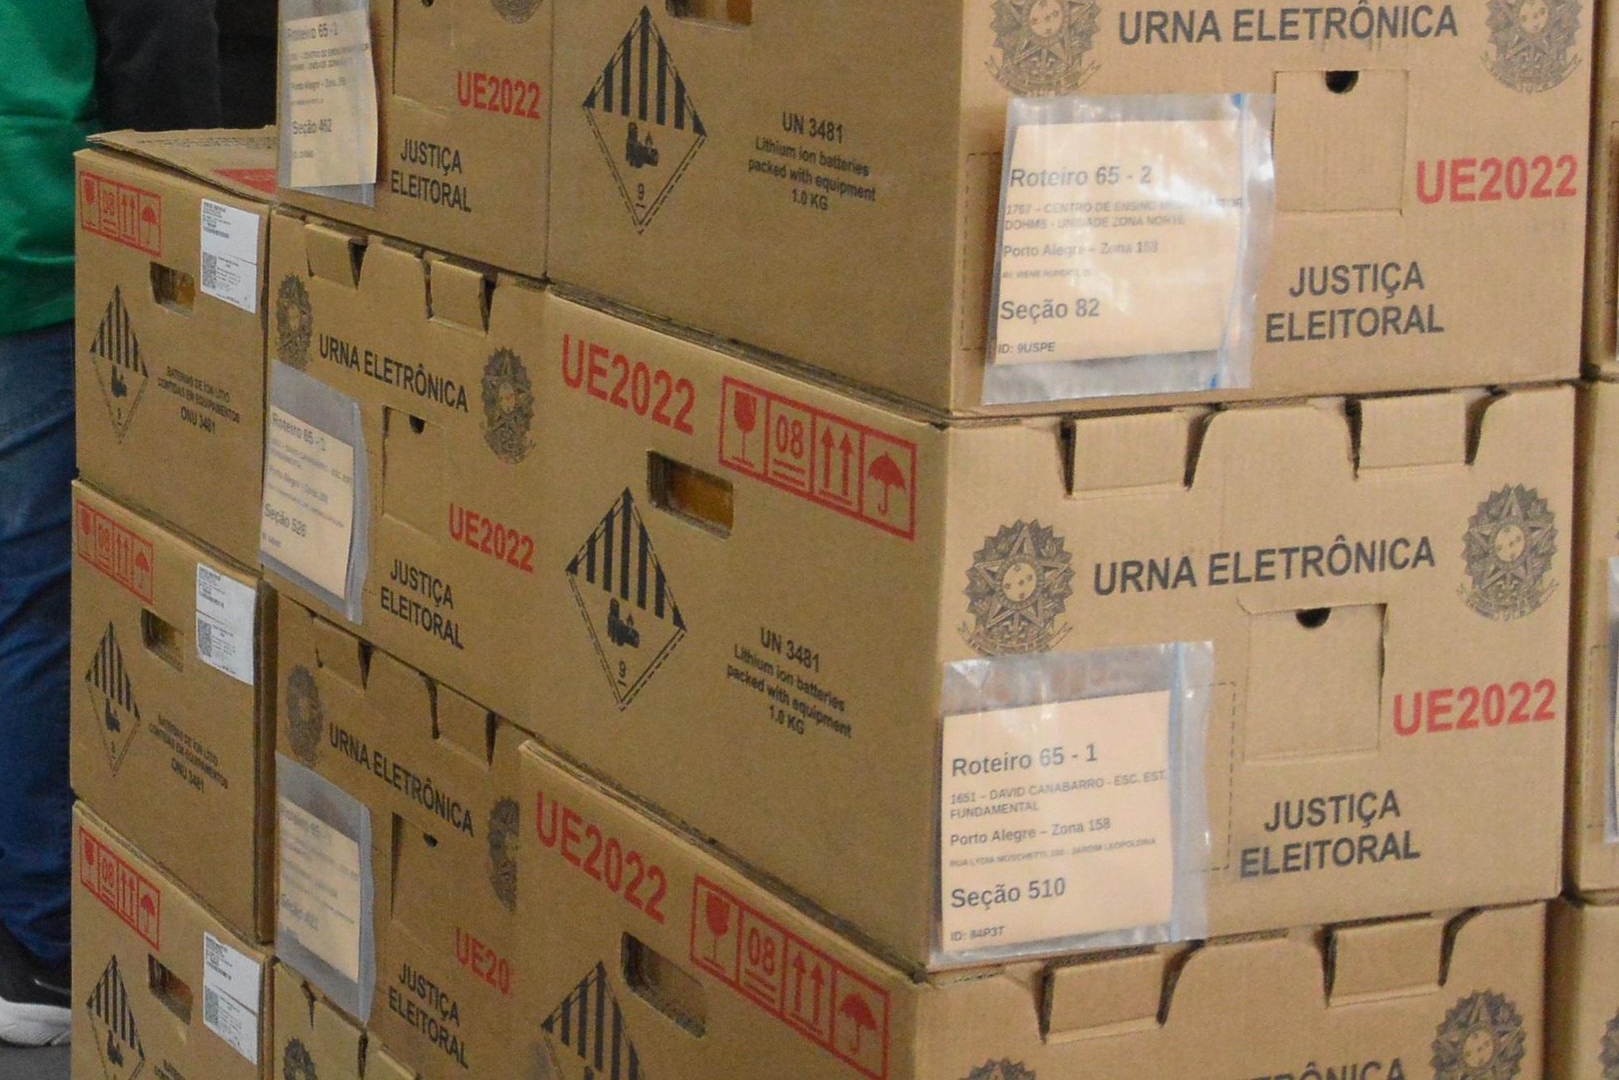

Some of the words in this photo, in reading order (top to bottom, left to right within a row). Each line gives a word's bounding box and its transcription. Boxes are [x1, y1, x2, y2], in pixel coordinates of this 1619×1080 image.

[1118, 9, 1221, 46] URNA
[457, 69, 541, 120] UE2022
[783, 112, 804, 134] UN
[809, 118, 843, 144] 3481
[400, 137, 462, 176] JUSTIÇA
[755, 136, 796, 159] Lithium
[800, 146, 816, 164] ion
[819, 151, 869, 176] batteries
[391, 170, 472, 213] ELEITORAL
[637, 183, 645, 201] 9
[748, 159, 786, 178] packed
[790, 168, 813, 184] with
[815, 175, 876, 201] equipment
[1011, 168, 1089, 187] Roteiro
[1096, 166, 1119, 184] 65
[1141, 166, 1152, 184] 2
[1417, 154, 1578, 205] UE2022
[792, 188, 807, 205] 1.0
[811, 193, 827, 210] KG
[1044, 202, 1091, 214] CENTRO
[1095, 201, 1111, 213] DE
[1112, 216, 1143, 228] ZONA
[1003, 244, 1039, 257] Porto
[1290, 261, 1425, 299] JUSTIÇA
[1000, 298, 1068, 324] Seção
[1075, 298, 1100, 317] 82
[1265, 304, 1445, 344] ELEITORAL
[998, 343, 1013, 354] ID:
[1017, 342, 1056, 353] 9USPE
[319, 333, 360, 374] URNA
[364, 350, 468, 413] ELETRÔNICA
[561, 334, 696, 436] UE2022
[775, 415, 805, 460] 08
[449, 503, 534, 573] UE2022
[1093, 557, 1195, 596] URNA
[1207, 532, 1436, 587] ELETRÔNICA
[390, 558, 454, 611] JUSTIÇA
[381, 586, 464, 651] ELEITORAL
[618, 660, 626, 679] 9
[761, 627, 781, 654] UN
[786, 640, 819, 672] 3481
[734, 643, 773, 676] Lithium
[777, 664, 794, 686] ion
[797, 675, 844, 712] batteries
[727, 664, 765, 692] packed
[767, 685, 790, 705] with
[792, 698, 851, 739] equipment
[1393, 678, 1557, 737] UE2022
[787, 714, 804, 735] KG
[329, 721, 371, 772] URNA
[374, 751, 474, 839] ELETRÔNICA
[952, 752, 1032, 777] Roteiro
[1039, 746, 1064, 767] 65
[1086, 743, 1098, 762] 1
[989, 786, 1025, 800] DAVID
[1028, 778, 1104, 796] CANABARRO
[1113, 773, 1140, 786] ESC.
[950, 801, 1039, 819] FUNDAMENTAL
[1264, 788, 1400, 834] JUSTIÇA
[950, 829, 987, 846] Porto
[991, 824, 1036, 843] Alegre
[1052, 822, 1084, 836] Zona
[1089, 818, 1111, 832] 158
[1239, 830, 1421, 879] ELEITORAL
[535, 790, 667, 926] UE2022
[749, 927, 777, 977] 08
[951, 884, 1020, 910] Seção
[1028, 877, 1066, 900] 510
[951, 931, 966, 942] ID:
[455, 926, 512, 998] UE20
[398, 962, 460, 1027] JUSTIÇA
[389, 985, 469, 1069] ELEITORAL
